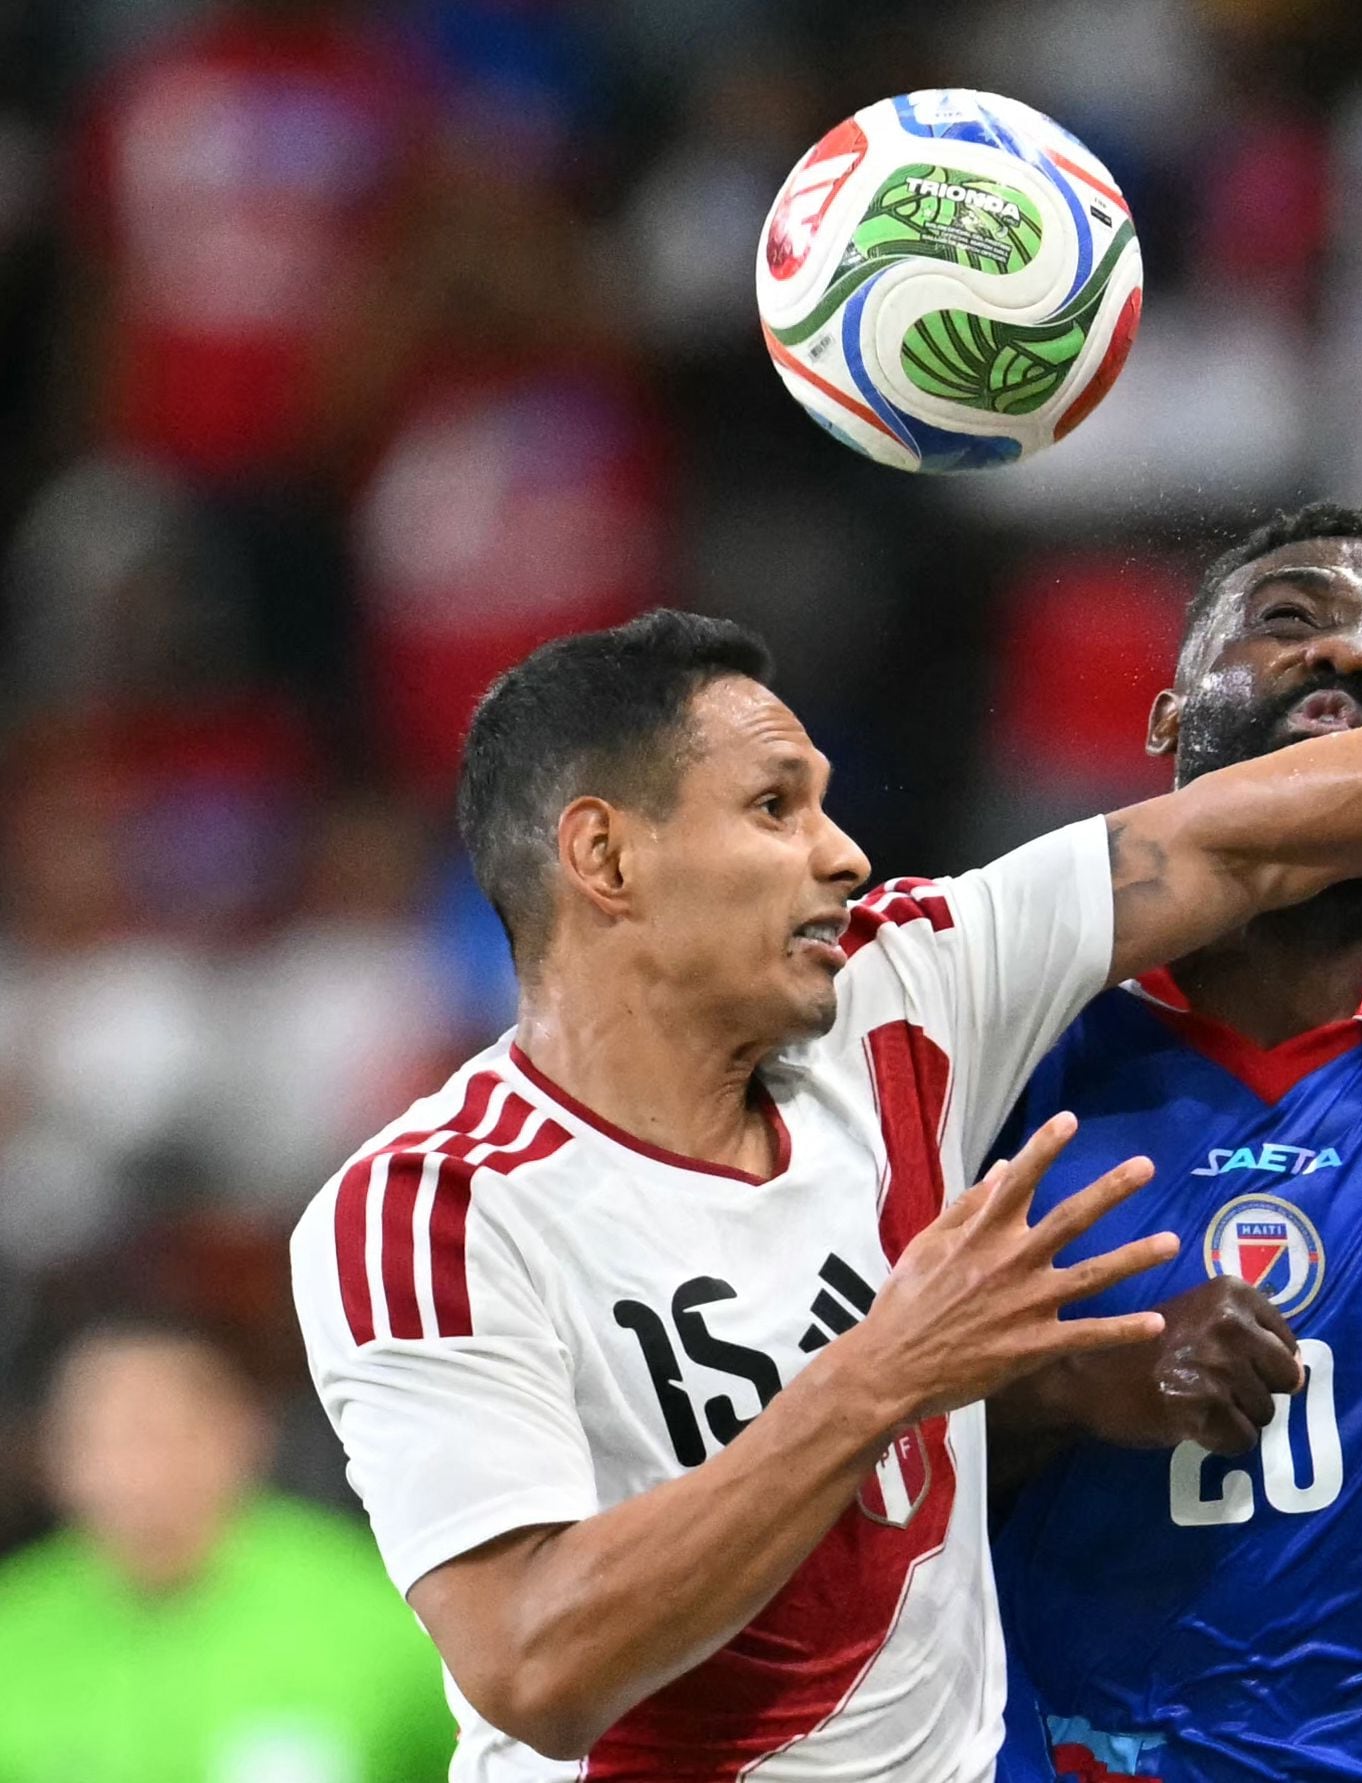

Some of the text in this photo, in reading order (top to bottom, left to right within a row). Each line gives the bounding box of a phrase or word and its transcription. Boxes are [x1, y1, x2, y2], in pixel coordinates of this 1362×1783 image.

[1190, 1143, 1343, 1177] SAETA
[1241, 1225, 1282, 1235] HAITI
[613, 1275, 782, 1468] 15
